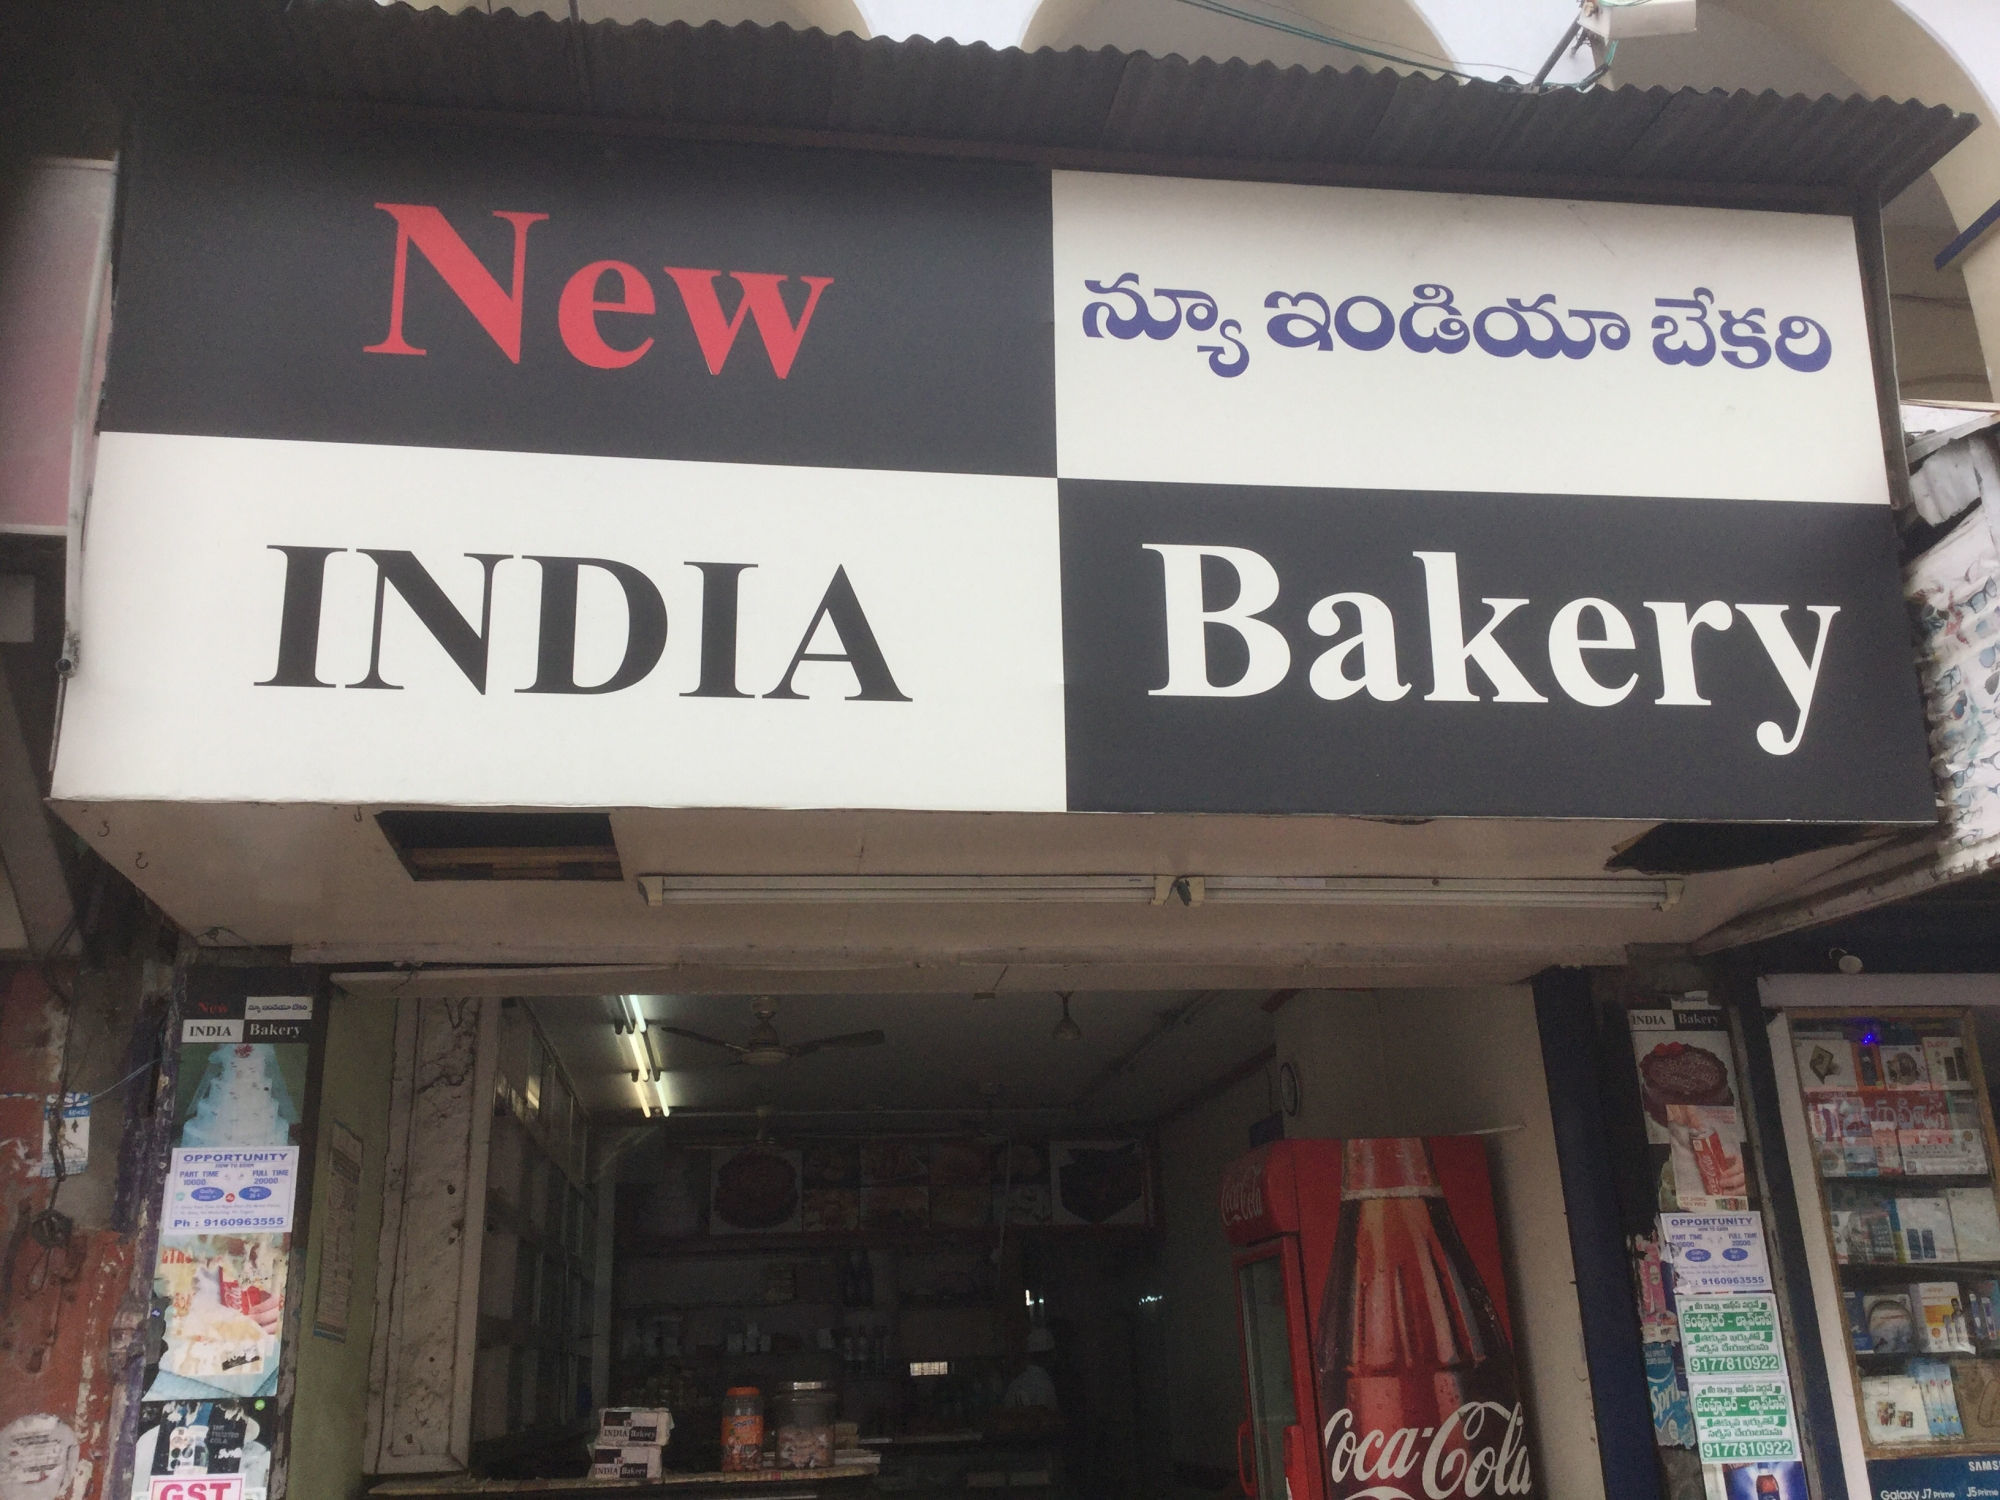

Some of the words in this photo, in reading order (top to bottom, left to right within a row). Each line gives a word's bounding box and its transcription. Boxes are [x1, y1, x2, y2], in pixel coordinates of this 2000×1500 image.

[365, 203, 833, 379] New
[1083, 273, 1249, 377] న్యూ
[1265, 284, 1631, 360] ఇండియా
[1652, 287, 1832, 373] బేకరి
[254, 546, 913, 702] INDIA
[1142, 544, 1841, 756] Bakery
[1632, 1015, 1667, 1025] INDIA
[1679, 1013, 1720, 1026] Bakery
[189, 1026, 231, 1036] INDIA
[249, 1024, 301, 1038] Bakery
[183, 1153, 288, 1162] OPPORTUNITY
[174, 1219, 190, 1227] Ph
[203, 1217, 284, 1226] 9160963555
[1671, 1218, 1752, 1226] OPPORTUNITY
[1702, 1276, 1764, 1285] 9160963555
[1692, 1356, 1778, 1371] 9177810922
[1324, 1401, 1531, 1500] Coca-Cola
[1704, 1441, 1792, 1457] 9177810922
[1968, 1460, 2000, 1472] SAMS
[160, 1483, 232, 1500] GST
[1880, 1489, 1920, 1500] Galaxy
[1921, 1488, 1931, 1499] J7
[1966, 1486, 1977, 1497] J5
